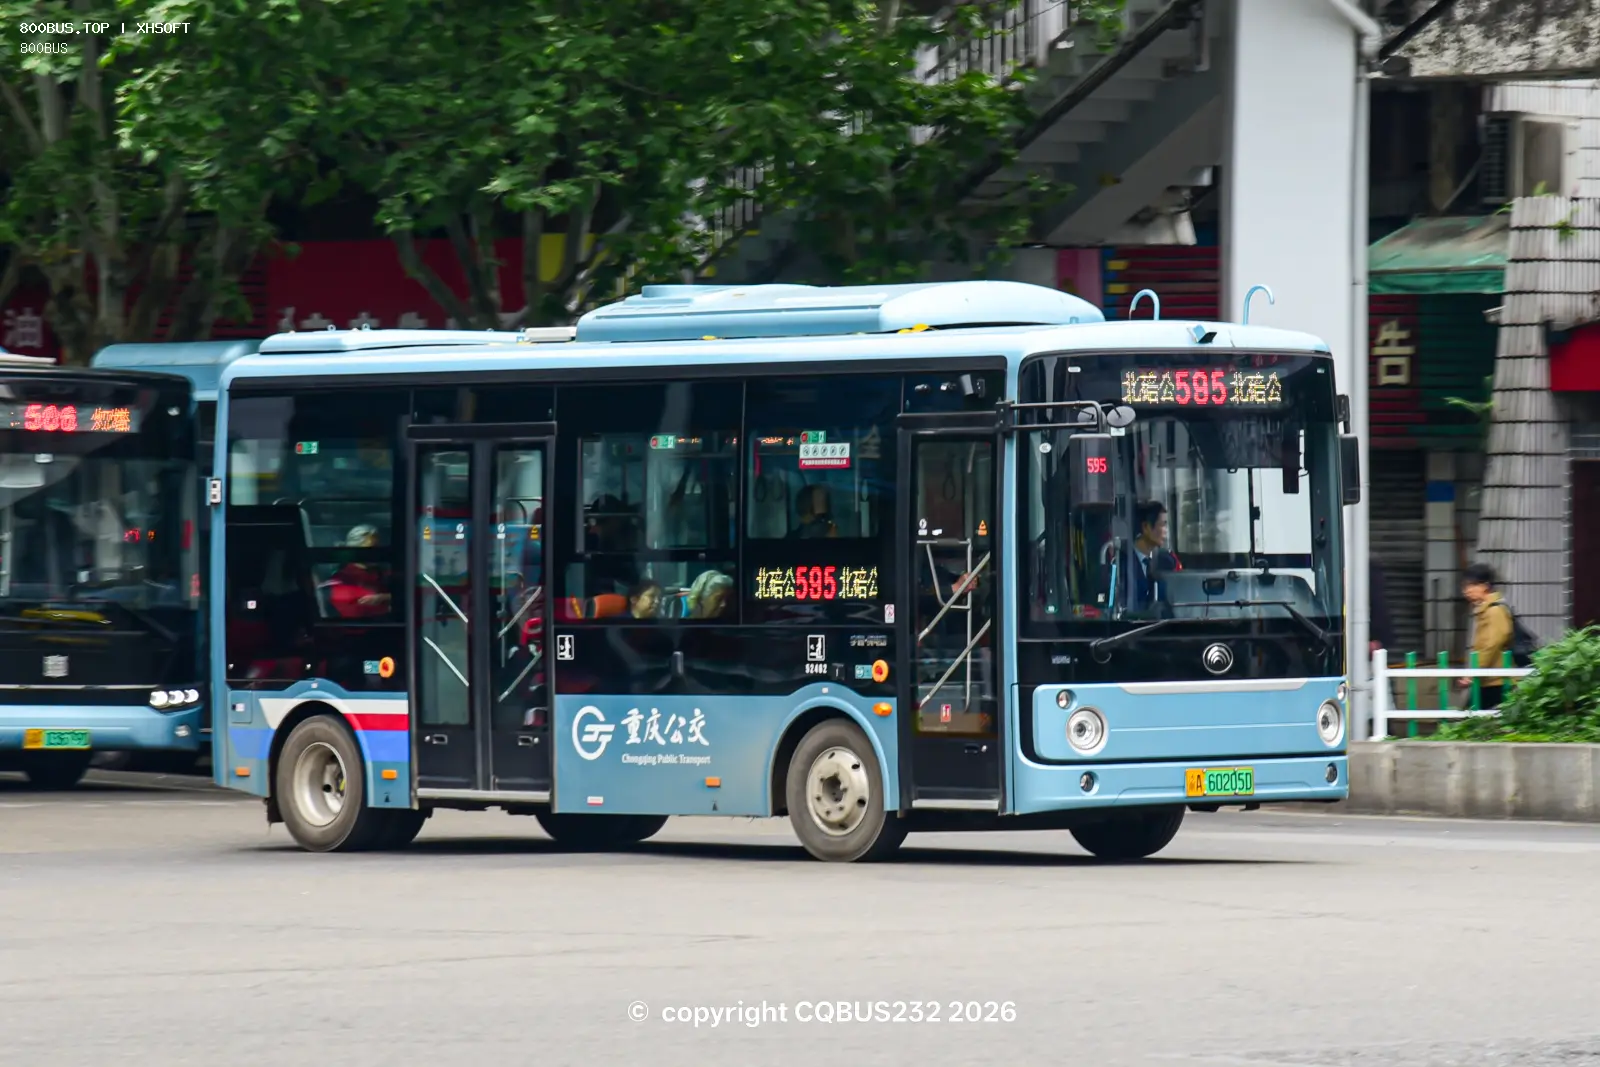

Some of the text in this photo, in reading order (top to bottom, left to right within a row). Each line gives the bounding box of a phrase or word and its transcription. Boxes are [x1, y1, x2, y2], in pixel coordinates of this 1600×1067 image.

[1372, 320, 1416, 386] 告
[24, 404, 78, 432] 506
[1086, 457, 1107, 474] 595
[795, 566, 837, 600] 595
[620, 707, 710, 746] 重庆公交
[621, 753, 711, 766] Chongqing Public Transport
